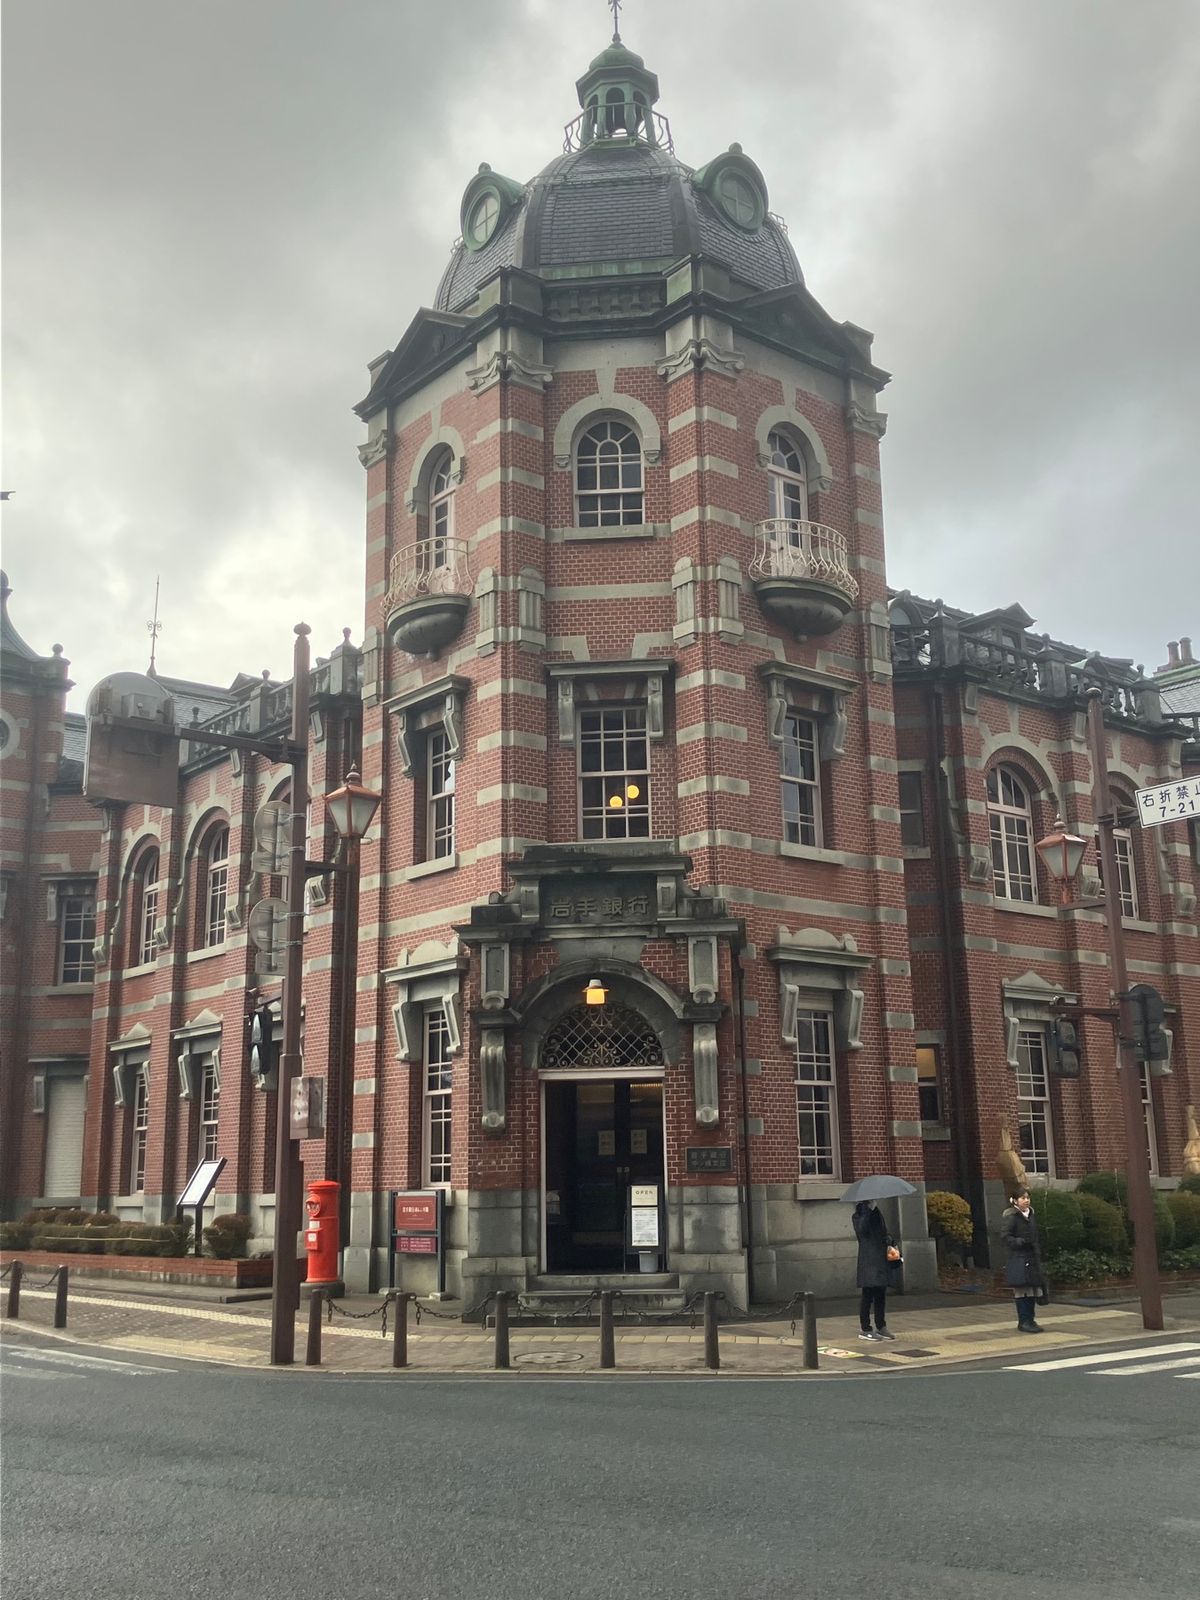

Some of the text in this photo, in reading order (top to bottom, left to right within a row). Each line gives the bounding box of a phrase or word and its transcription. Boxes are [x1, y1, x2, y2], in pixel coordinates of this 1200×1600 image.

[1159, 800, 1195, 817] 7-21
[551, 896, 649, 918] 岩手銀行
